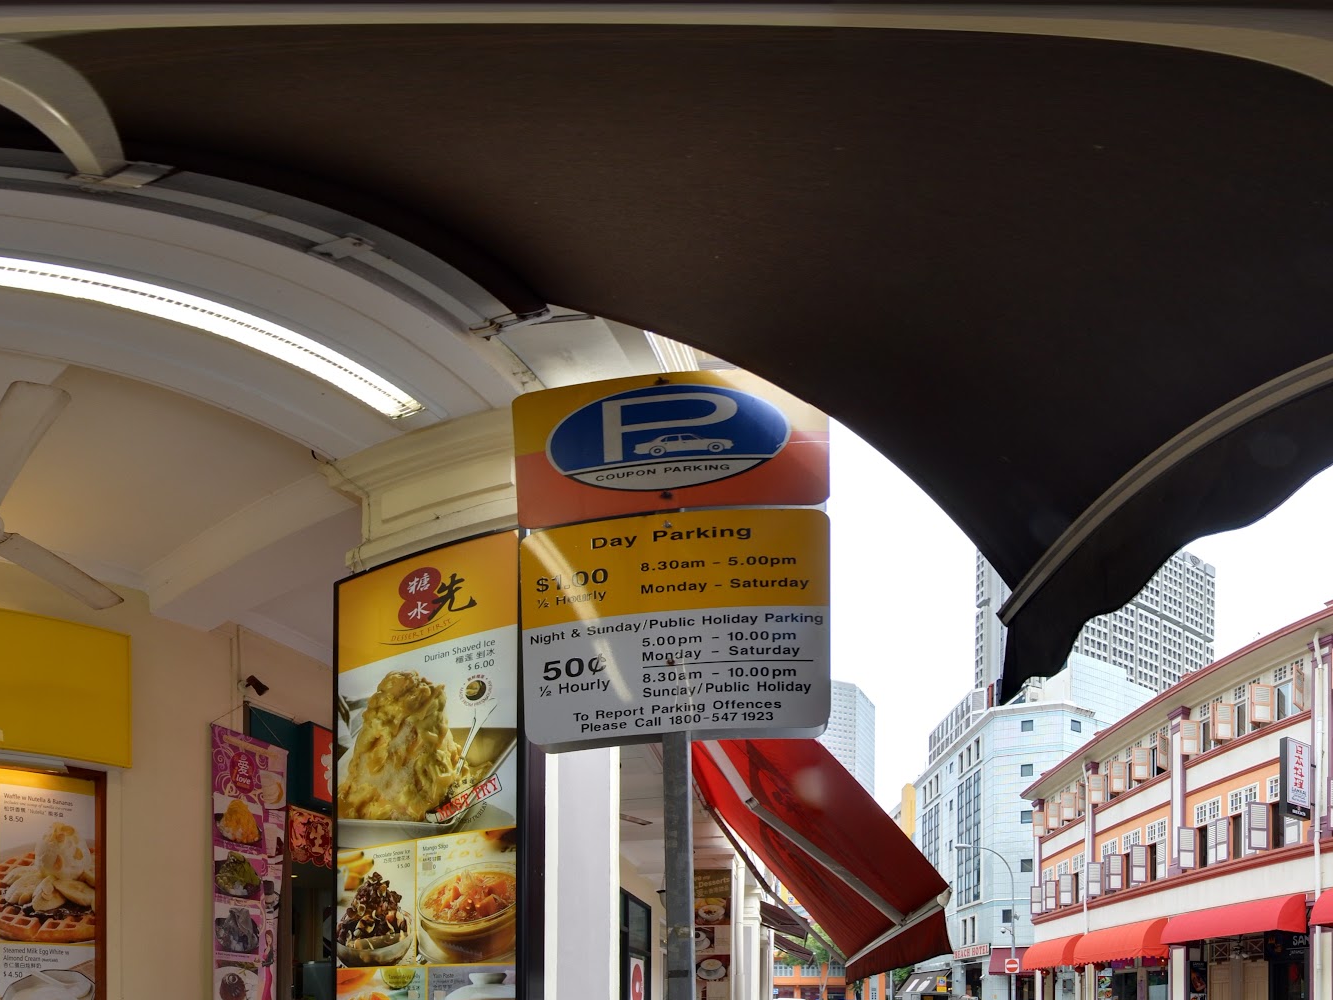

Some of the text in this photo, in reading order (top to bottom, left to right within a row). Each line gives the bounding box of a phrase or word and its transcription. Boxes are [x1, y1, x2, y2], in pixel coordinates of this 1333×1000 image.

[595, 463, 731, 482] COUPON PARKING
[591, 526, 752, 550] Day Parking
[641, 555, 797, 572] 8.30am 5.00pm
[536, 568, 609, 593] $1.00
[641, 577, 809, 594] Monday Saturday
[556, 589, 606, 606] Hourly
[390, 618, 452, 642] DESSERT FIRST
[530, 612, 824, 646] Night & Sunday/Public Holiday Parking
[642, 631, 797, 649] 5.00pm 10.00pm
[424, 638, 496, 663] Durian Shaved Ice
[642, 646, 800, 663] Monday Saturday
[474, 659, 495, 670] 6.00
[642, 667, 797, 683] 8.30am 10.00pm
[558, 679, 611, 696] Hourly
[642, 682, 812, 699] Sunday/Public Holiday
[573, 700, 782, 723] To Report Parking Offences
[581, 720, 627, 733] Please
[635, 716, 662, 728] Call
[742, 711, 774, 721] 1923
[27, 795, 46, 803] Nutella
[52, 799, 73, 807] Bananas
[436, 793, 470, 821] MUST
[471, 777, 499, 801] TRY
[9, 815, 24, 823] 8.50
[698, 876, 731, 888] Desserts
[954, 944, 990, 959] BEACH HOTEL
